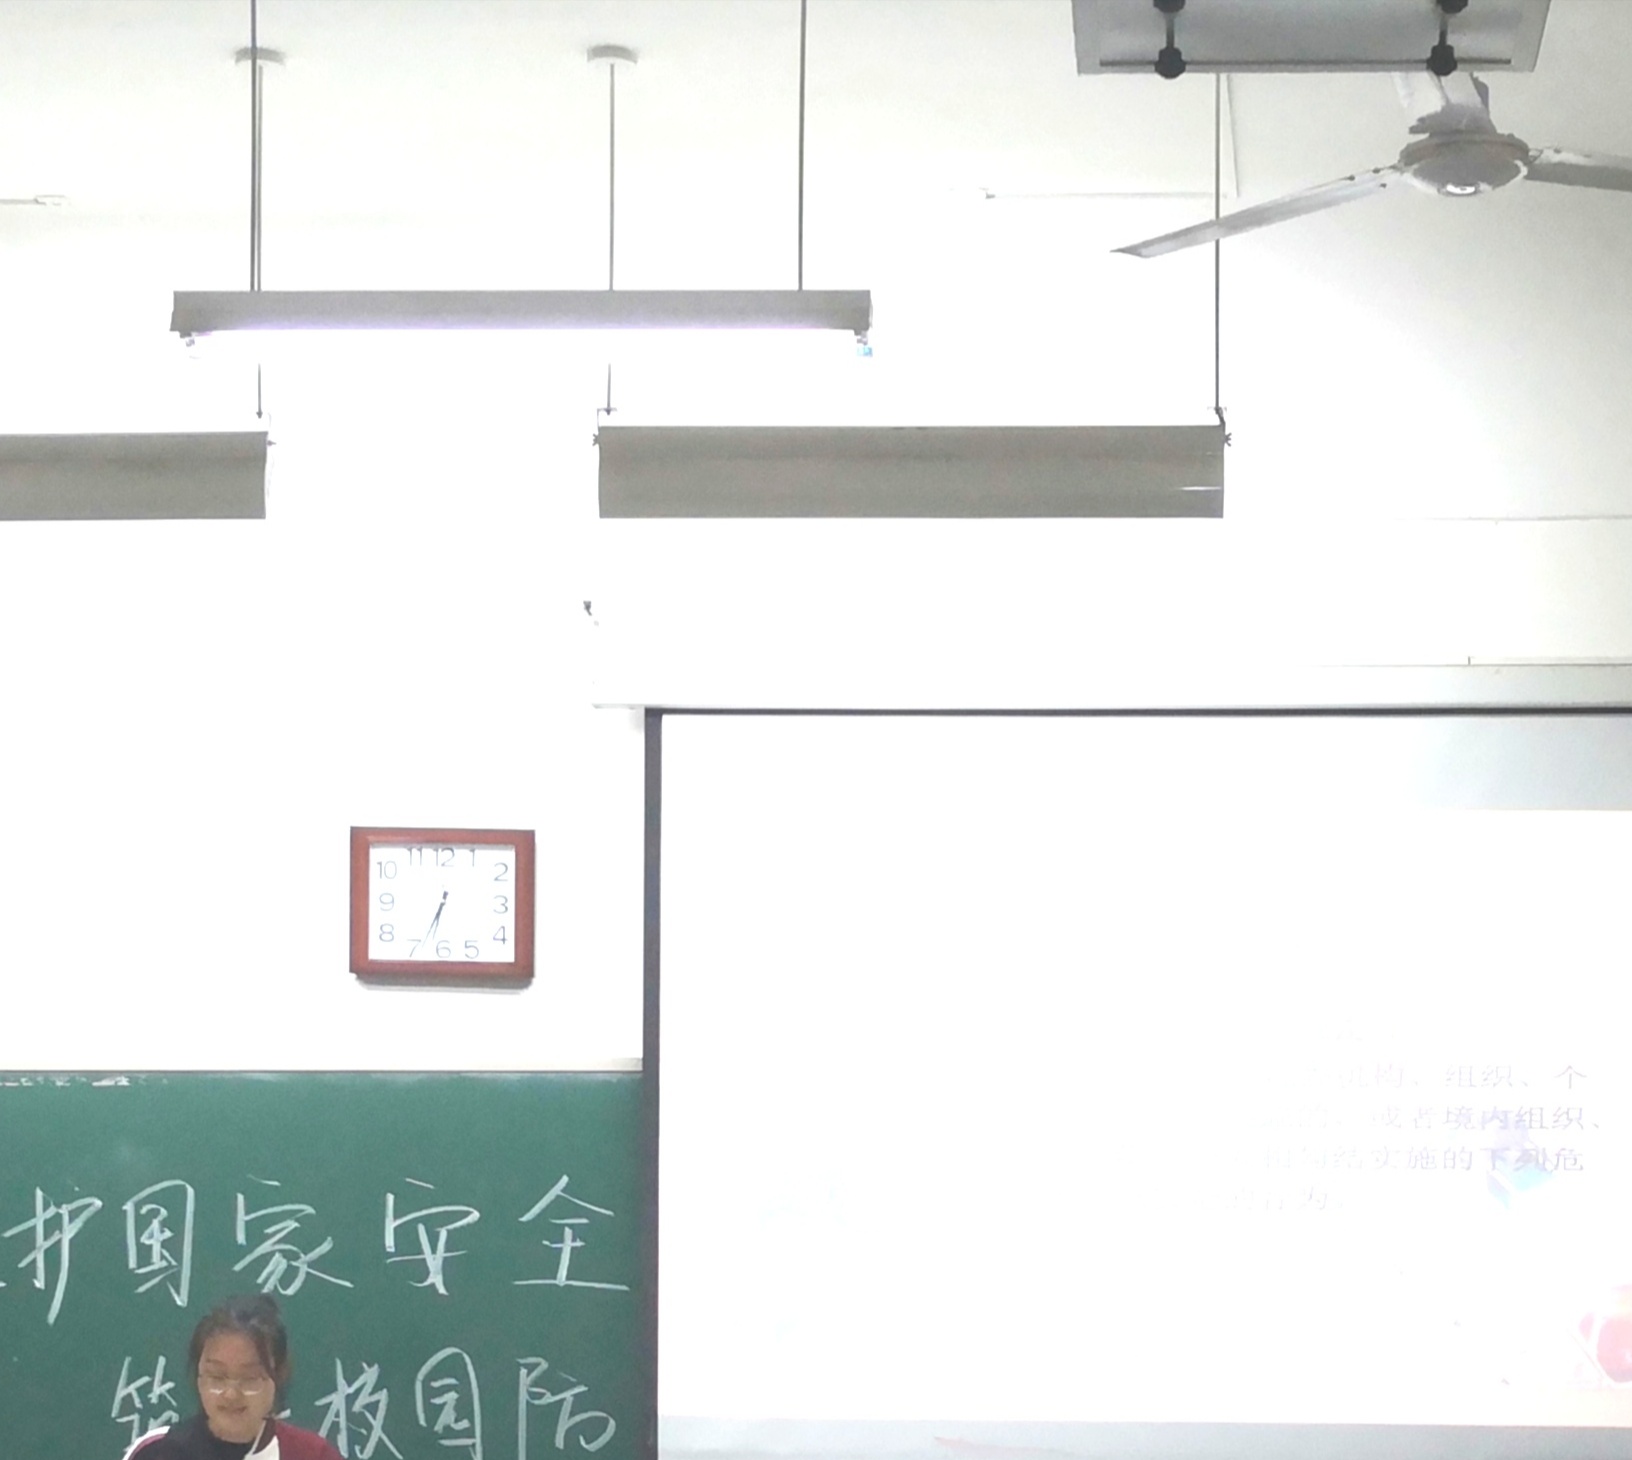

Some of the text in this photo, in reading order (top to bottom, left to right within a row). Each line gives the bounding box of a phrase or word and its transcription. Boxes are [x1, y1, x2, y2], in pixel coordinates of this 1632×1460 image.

[407, 846, 423, 867] 11
[432, 846, 456, 867] 12
[469, 847, 476, 867] 1
[376, 860, 397, 879] 10
[493, 862, 509, 882] 2
[379, 893, 395, 912] 9
[493, 895, 509, 914] 3
[379, 923, 395, 942] 8
[492, 925, 508, 945] 4
[407, 938, 422, 958] 7
[435, 939, 452, 959] 6
[464, 939, 480, 959] 5
